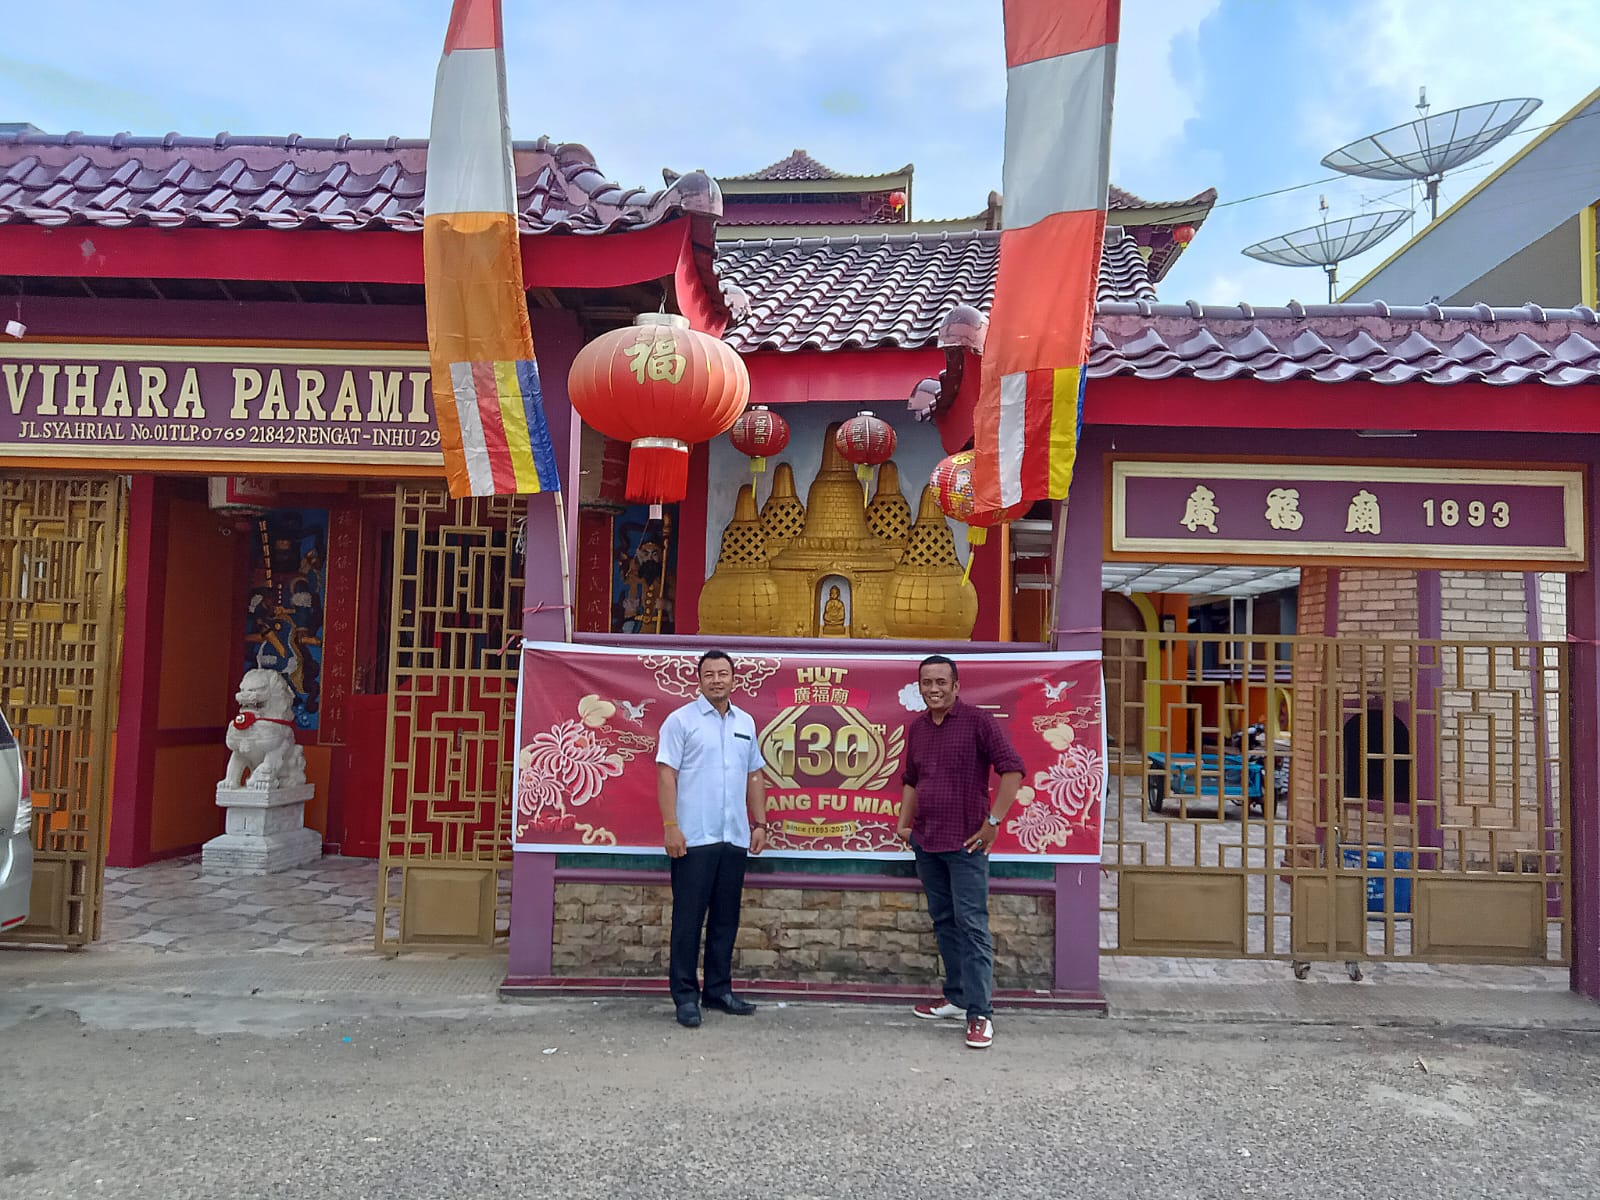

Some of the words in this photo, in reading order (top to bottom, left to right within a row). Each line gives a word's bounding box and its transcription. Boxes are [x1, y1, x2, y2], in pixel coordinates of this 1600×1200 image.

[623, 337, 687, 385] 福
[2, 364, 206, 419] VIHARA
[230, 367, 431, 423] PARAMI
[1422, 499, 1511, 528] 1893
[796, 666, 849, 684] HUT
[794, 686, 849, 705] 廣福廟
[818, 794, 847, 811] FU
